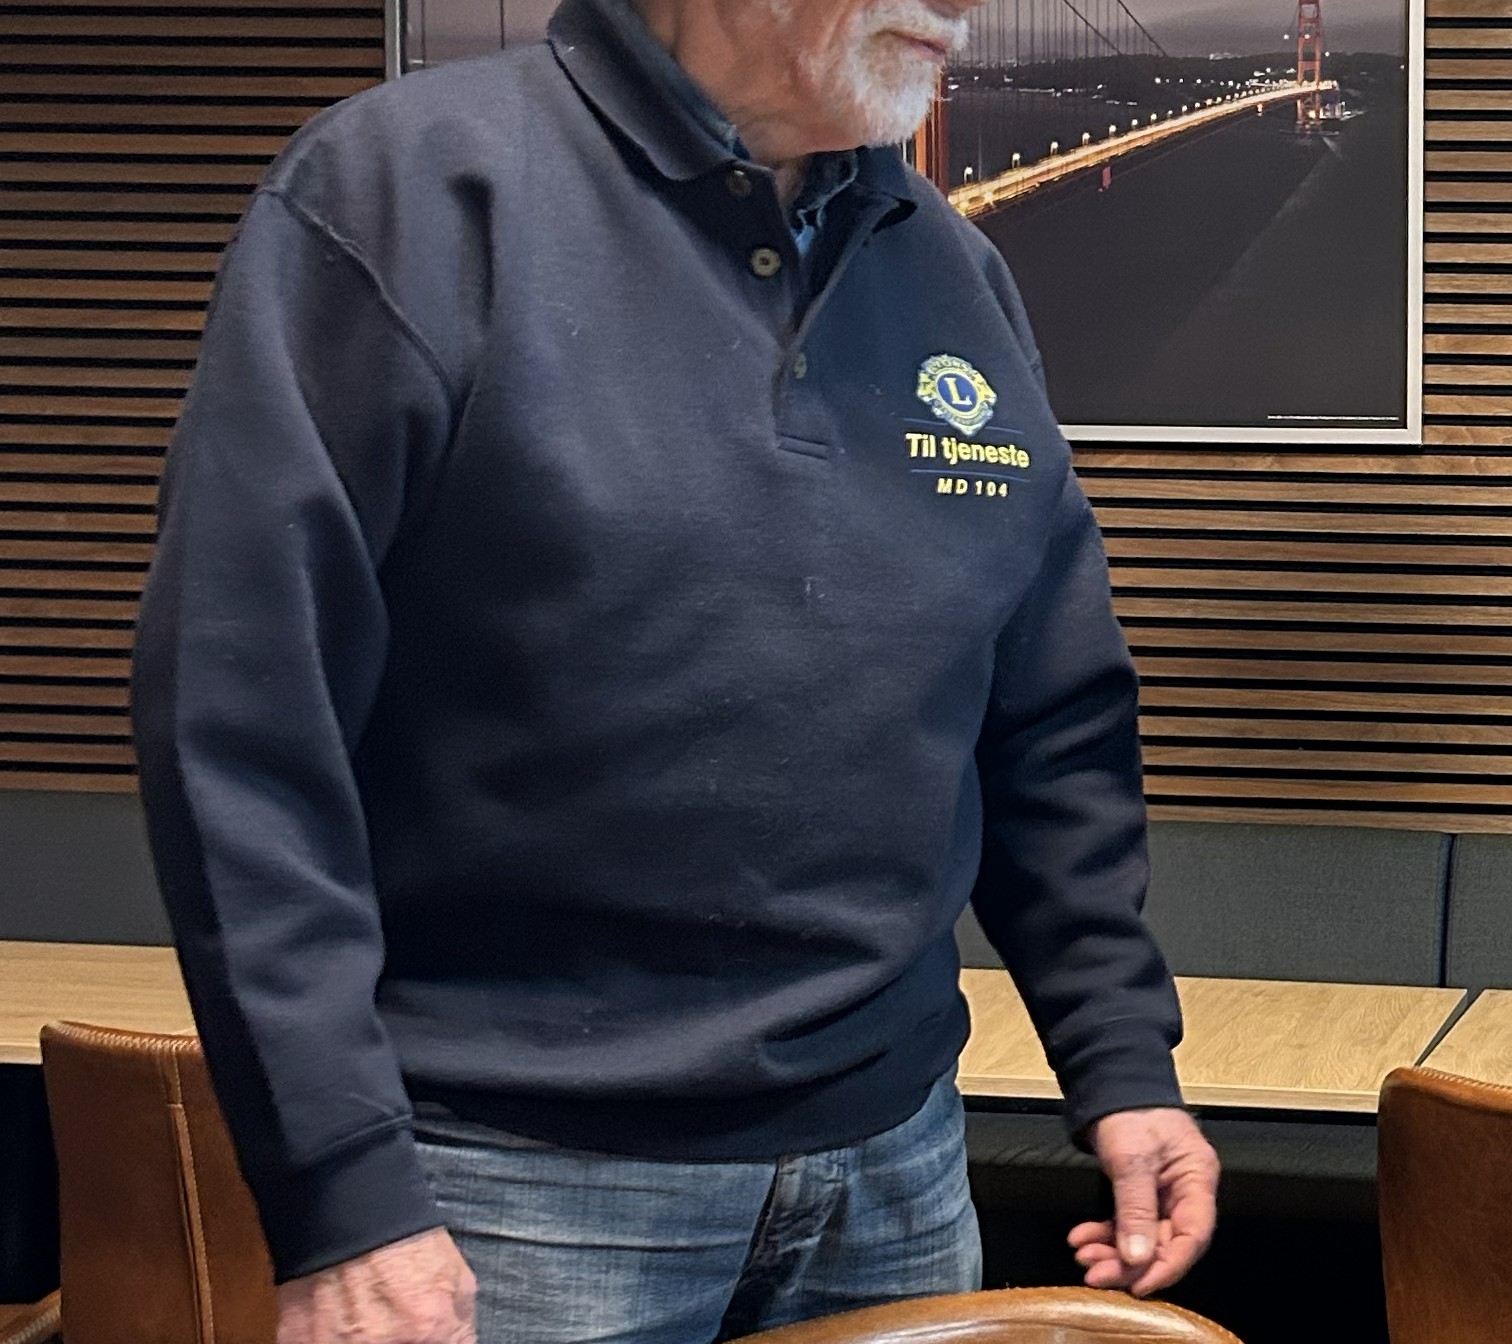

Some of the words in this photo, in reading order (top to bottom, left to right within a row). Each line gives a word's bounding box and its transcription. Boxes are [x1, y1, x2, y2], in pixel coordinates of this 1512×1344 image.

[944, 377, 973, 405] L
[905, 433, 936, 458] Til
[942, 437, 1030, 468] tjeneste
[937, 478, 968, 495] MD
[975, 480, 1009, 498] 104
